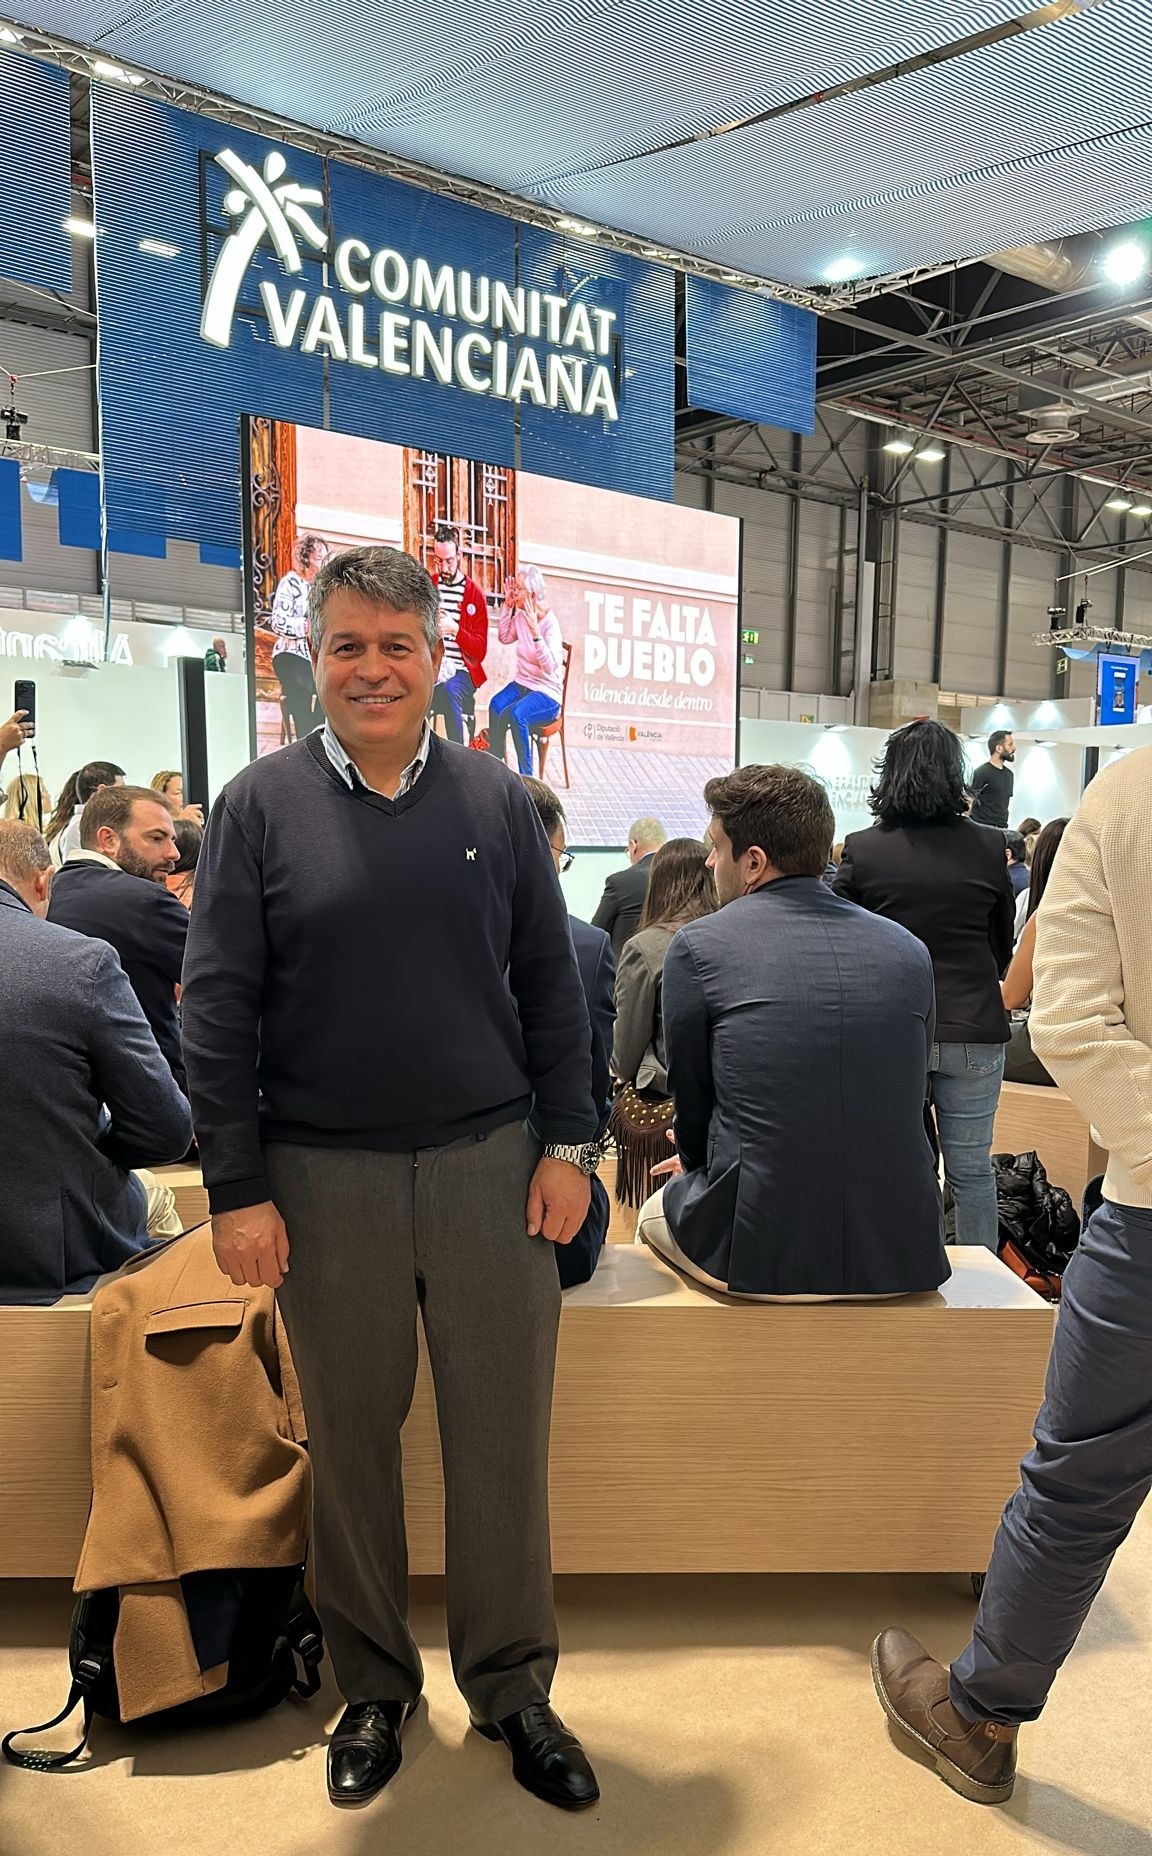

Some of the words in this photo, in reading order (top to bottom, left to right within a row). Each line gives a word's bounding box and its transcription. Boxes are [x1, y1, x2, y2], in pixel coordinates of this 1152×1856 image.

[333, 238, 617, 356] COMUNITAT
[259, 280, 619, 421] VALENCIANA
[583, 590, 625, 635] TE
[632, 597, 718, 647] FALTA
[583, 634, 716, 687] PUEBLO
[637, 686, 675, 708] desde
[674, 690, 713, 712] dentro
